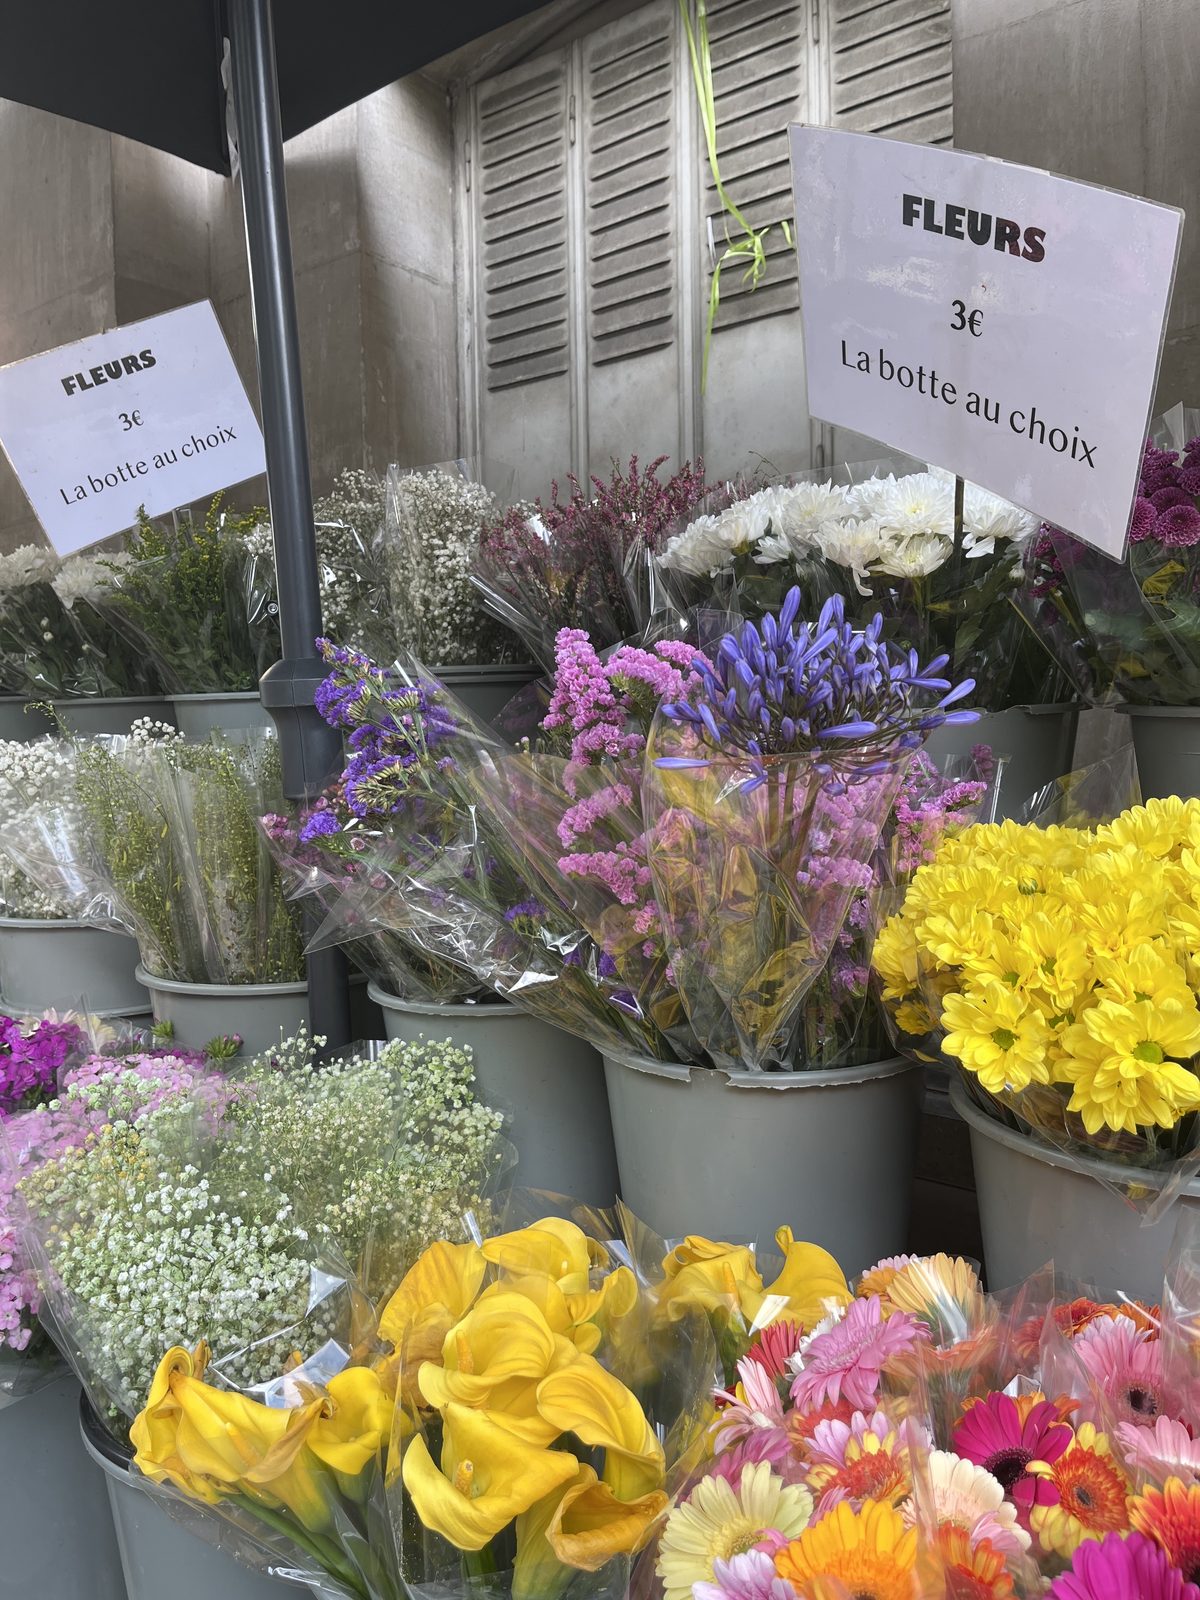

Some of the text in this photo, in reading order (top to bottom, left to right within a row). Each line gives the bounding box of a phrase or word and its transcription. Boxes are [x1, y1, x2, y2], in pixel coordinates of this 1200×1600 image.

[902, 193, 1047, 263] FLEURS
[950, 299, 984, 338] 3€
[61, 349, 157, 397] FLEURS
[118, 409, 144, 432] 3€
[841, 339, 1098, 469] La botte au choix
[60, 425, 238, 505] La botte au choix
